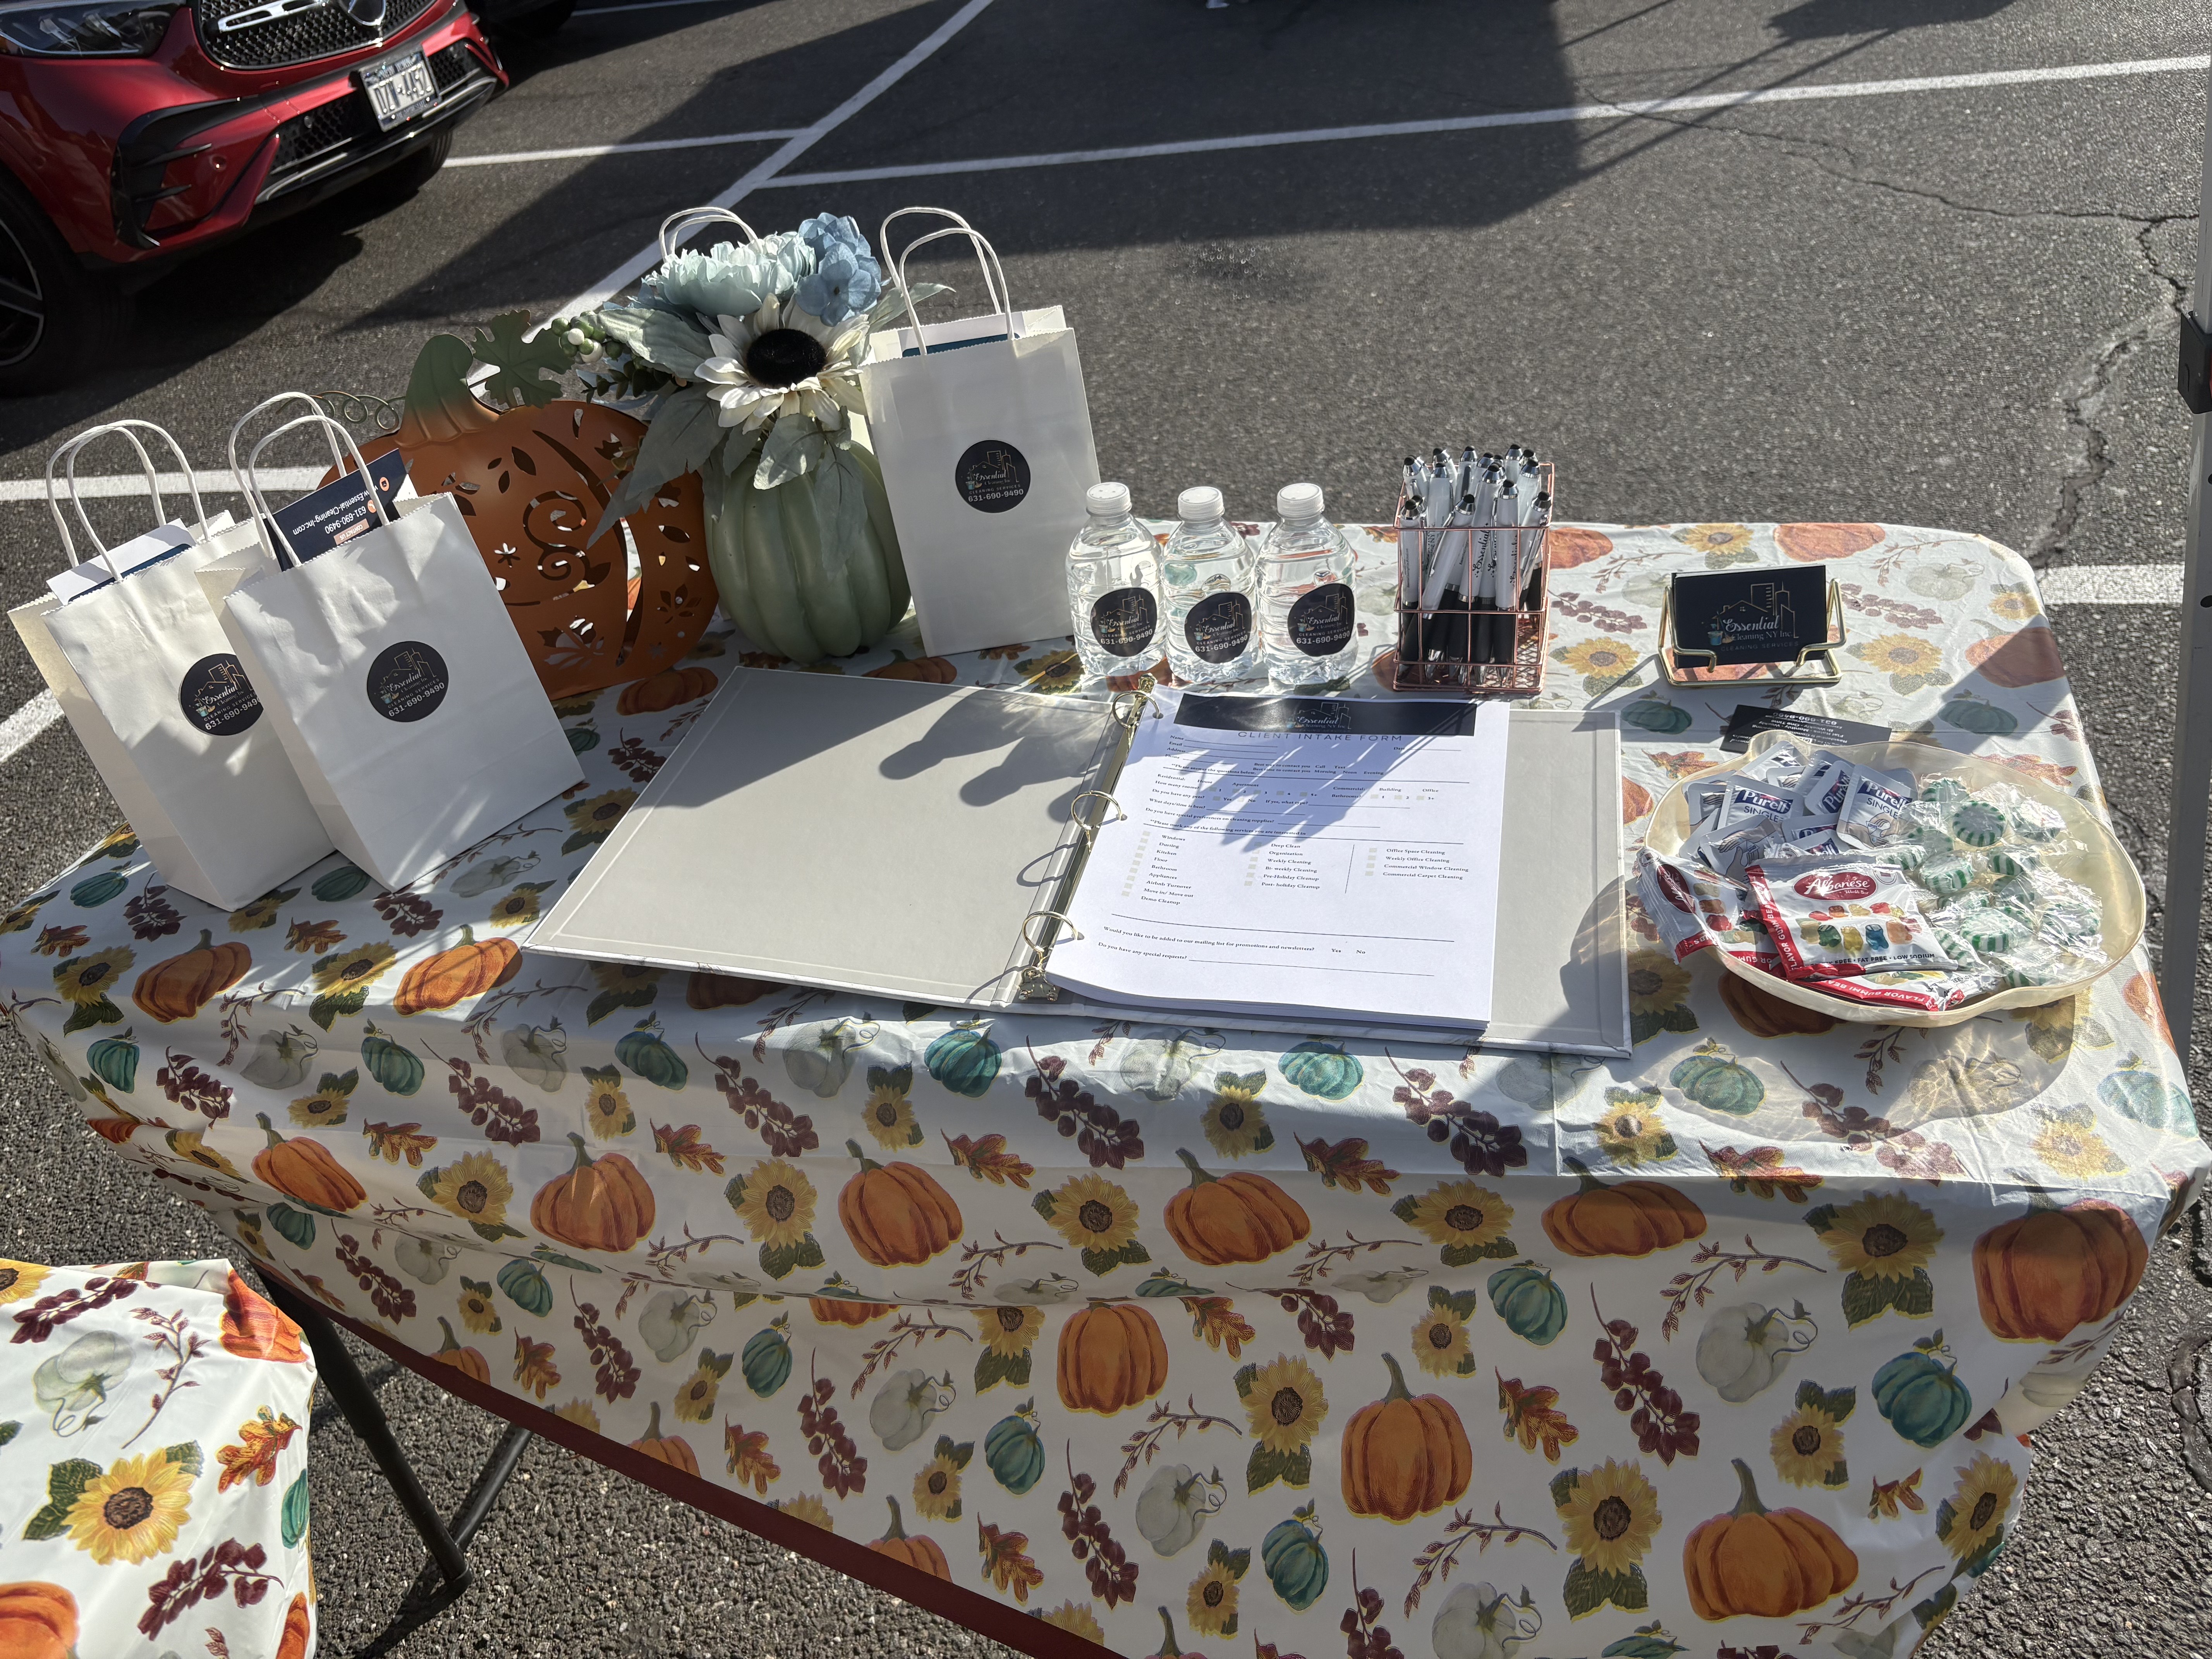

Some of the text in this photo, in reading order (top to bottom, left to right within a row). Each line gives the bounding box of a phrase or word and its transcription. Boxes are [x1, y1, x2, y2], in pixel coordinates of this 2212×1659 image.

[968, 489, 1024, 501] 631-690-9490
[325, 506, 366, 534] 631-690-9490
[346, 524, 363, 538] CONTACT
[1308, 613, 1340, 624] Essential
[1723, 615, 1780, 632] Essential
[1129, 625, 1150, 635] SERVICES
[1203, 620, 1235, 633] Essential
[1328, 626, 1348, 634] SERVICES
[1101, 629, 1152, 644] 631-690-9490
[1195, 634, 1248, 652] 631-690-9490
[1224, 630, 1246, 641] SERVICES
[1297, 630, 1350, 644] 631-690-9490
[387, 669, 421, 691] Essential
[202, 681, 238, 704] Essential
[388, 678, 439, 708] CLEANING SERVICES
[389, 682, 444, 716] 631-690-9490
[204, 706, 230, 721] CLEANING
[1297, 716, 1339, 725] Essential
[1742, 791, 1790, 813] Purell
[1866, 782, 1909, 809] Purell
[1744, 805, 1783, 823] SINGLE
[1804, 878, 1870, 895] Albanese
[1771, 919, 1785, 939] GUMM
[1849, 987, 1881, 996] GUMMI
[1884, 993, 1925, 1001] FLAVOR
